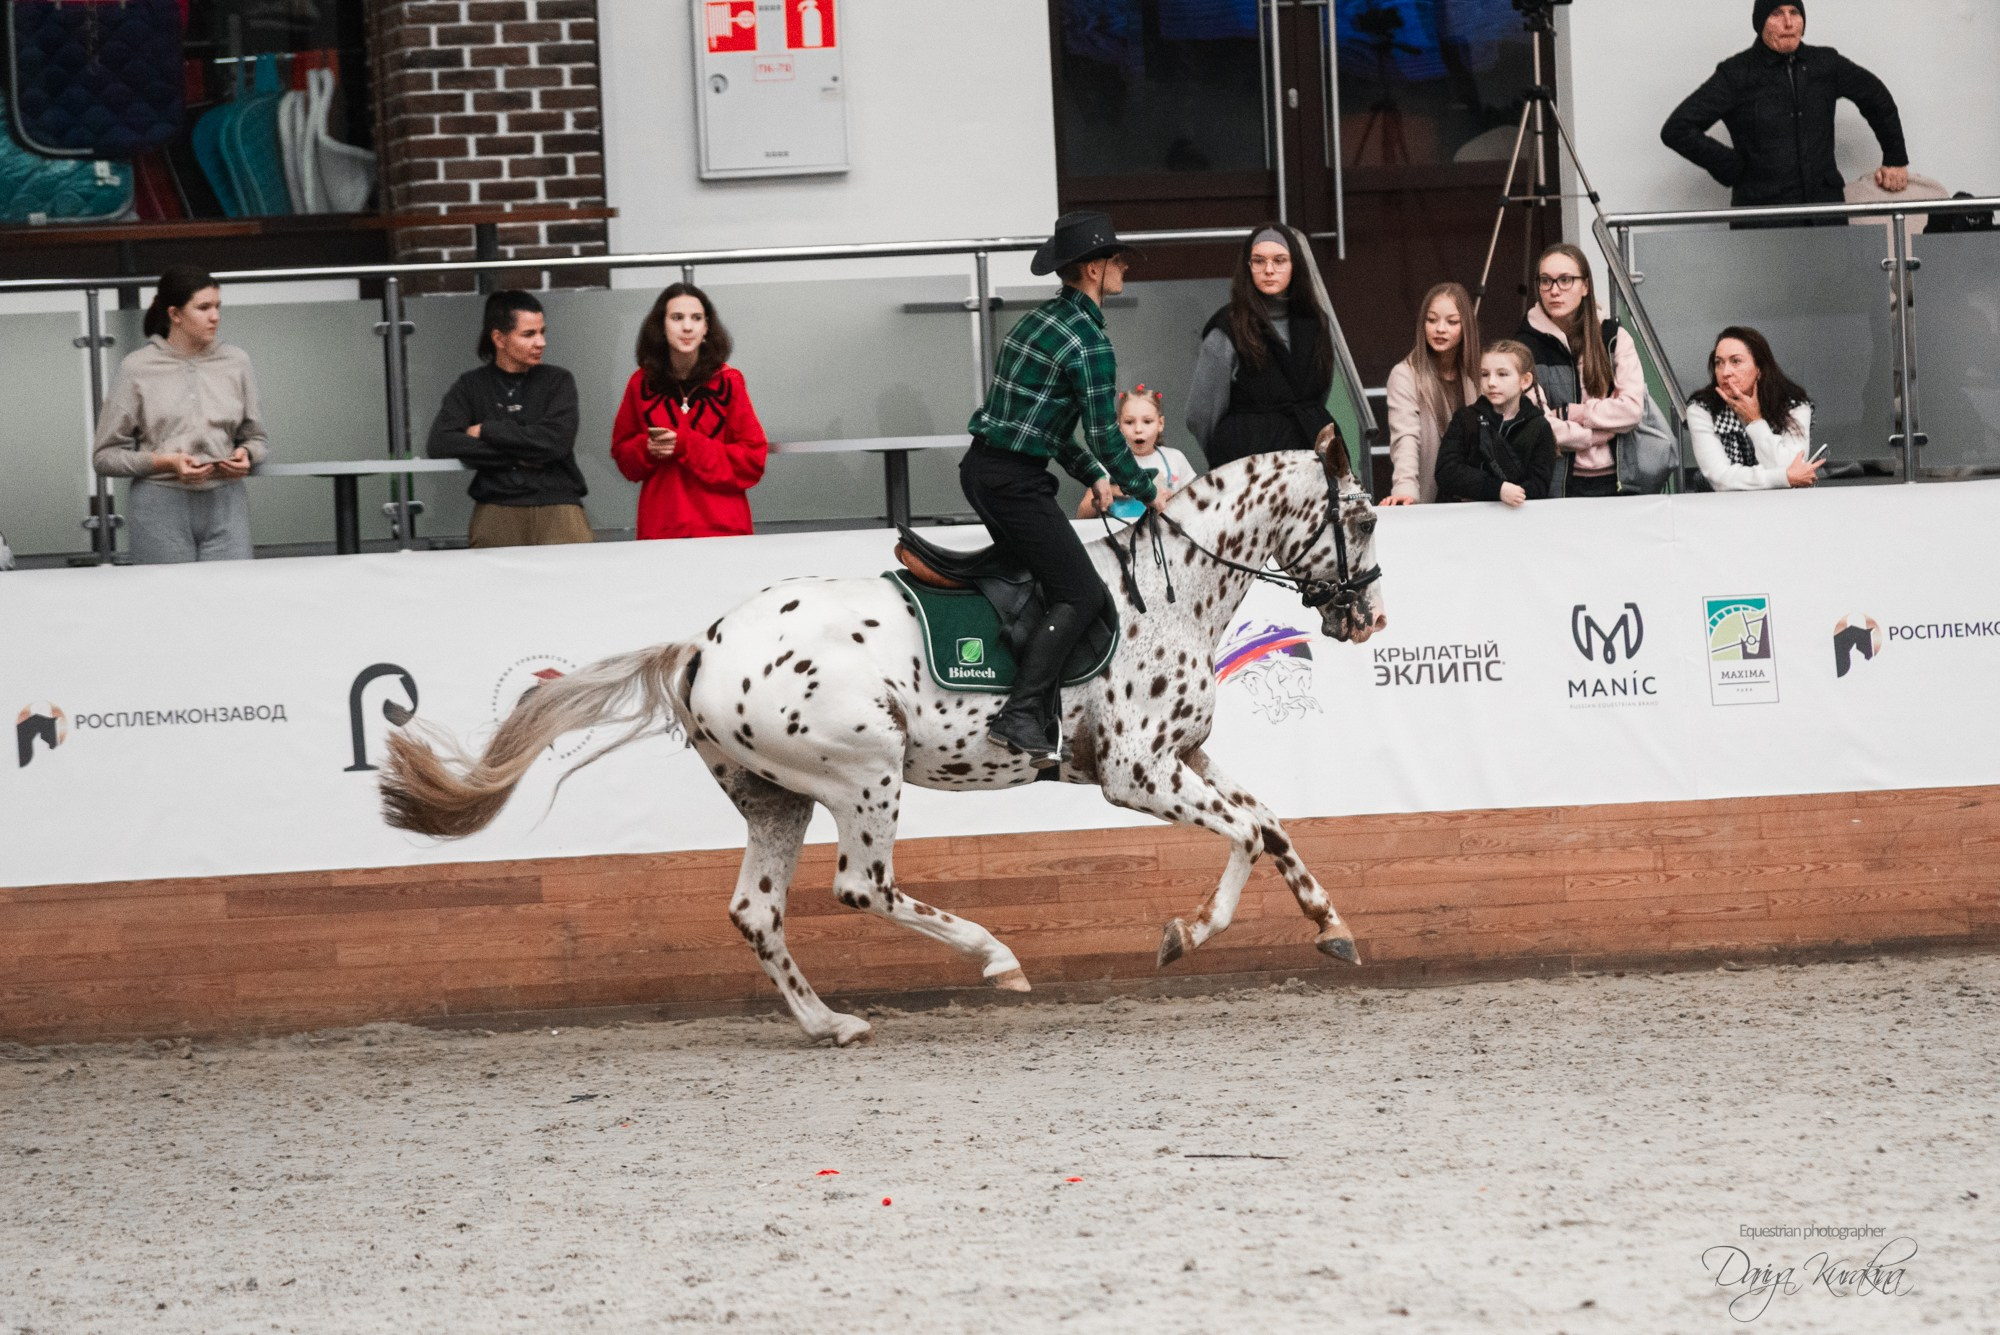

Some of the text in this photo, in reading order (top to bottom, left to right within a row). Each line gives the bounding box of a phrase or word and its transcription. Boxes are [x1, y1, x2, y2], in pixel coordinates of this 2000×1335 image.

[1373, 640, 1499, 663] КРЫЛАТЫЙ
[948, 667, 996, 679] Biotech
[1373, 660, 1503, 687] ЭКЛИПС
[1721, 669, 1765, 680] MAXIMA
[75, 704, 288, 729] РОСПЛЕМКОНЗАВОД
